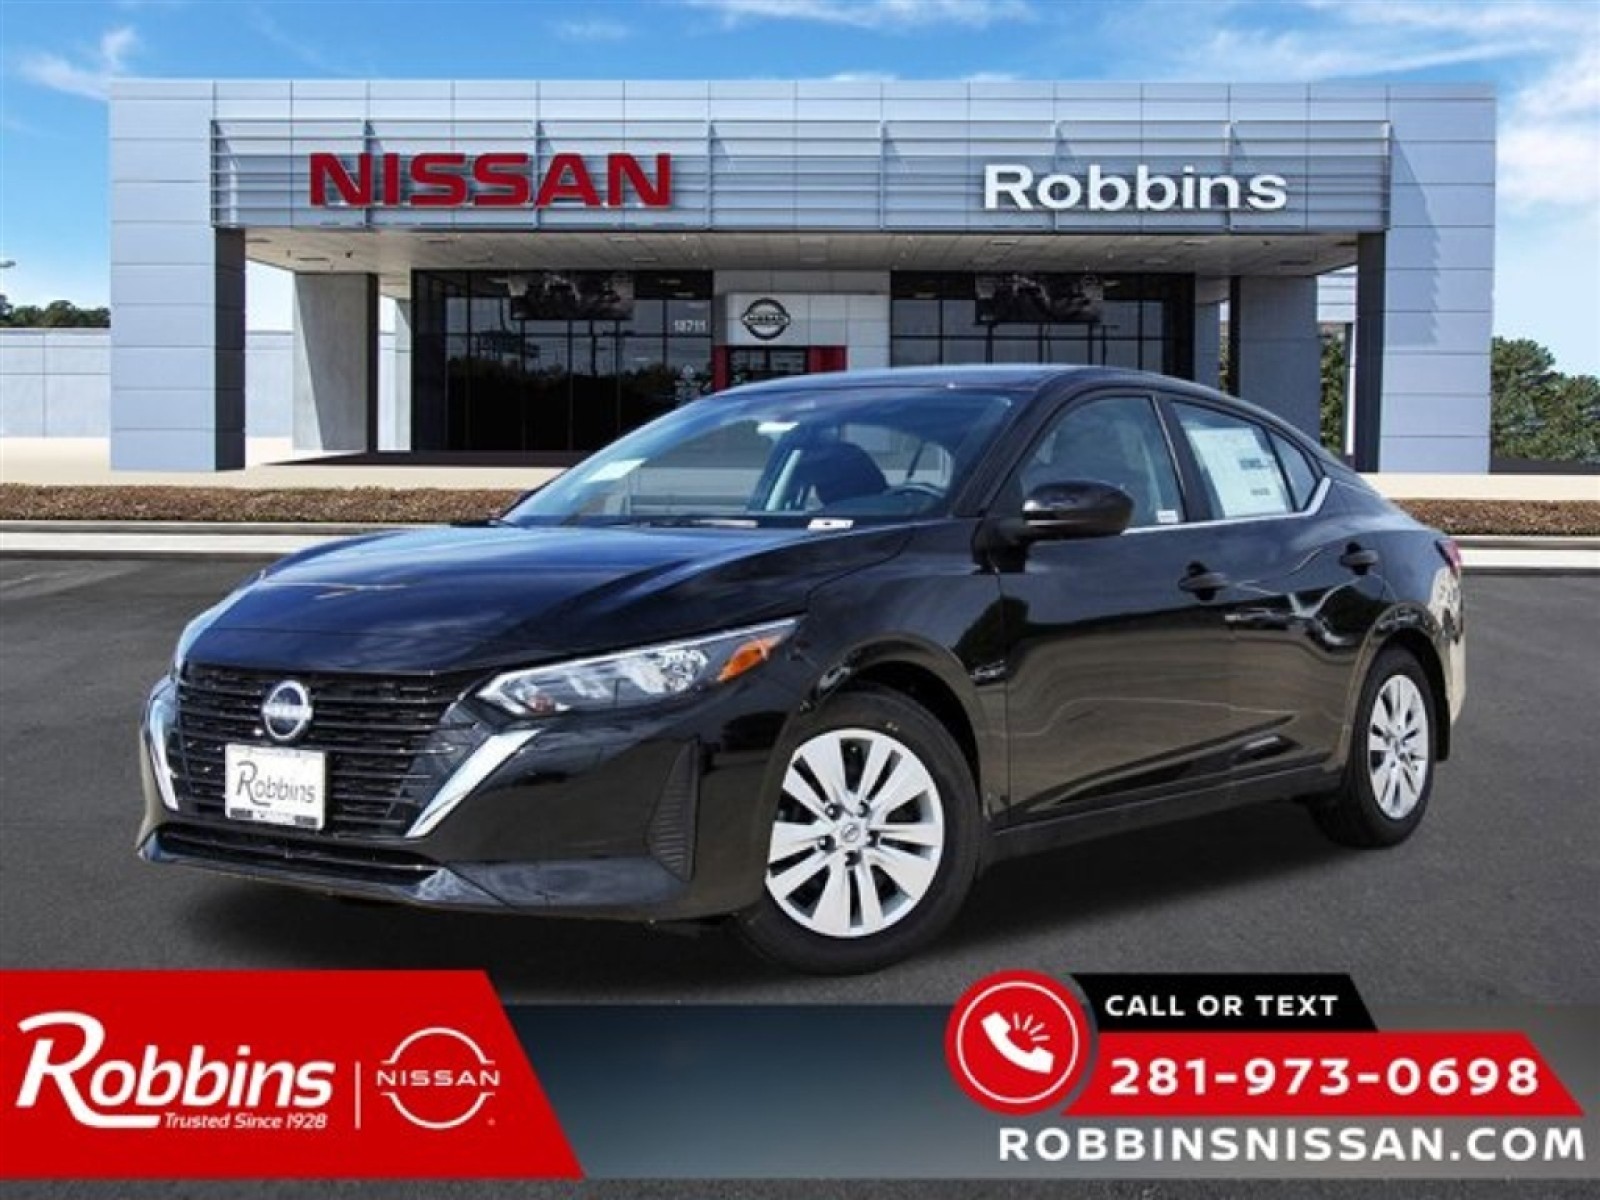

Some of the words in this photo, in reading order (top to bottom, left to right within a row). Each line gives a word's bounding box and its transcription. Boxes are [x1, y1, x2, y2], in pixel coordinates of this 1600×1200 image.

[309, 153, 671, 208] NISSAN
[984, 164, 1287, 211] Robbins
[236, 760, 315, 807] Robbins
